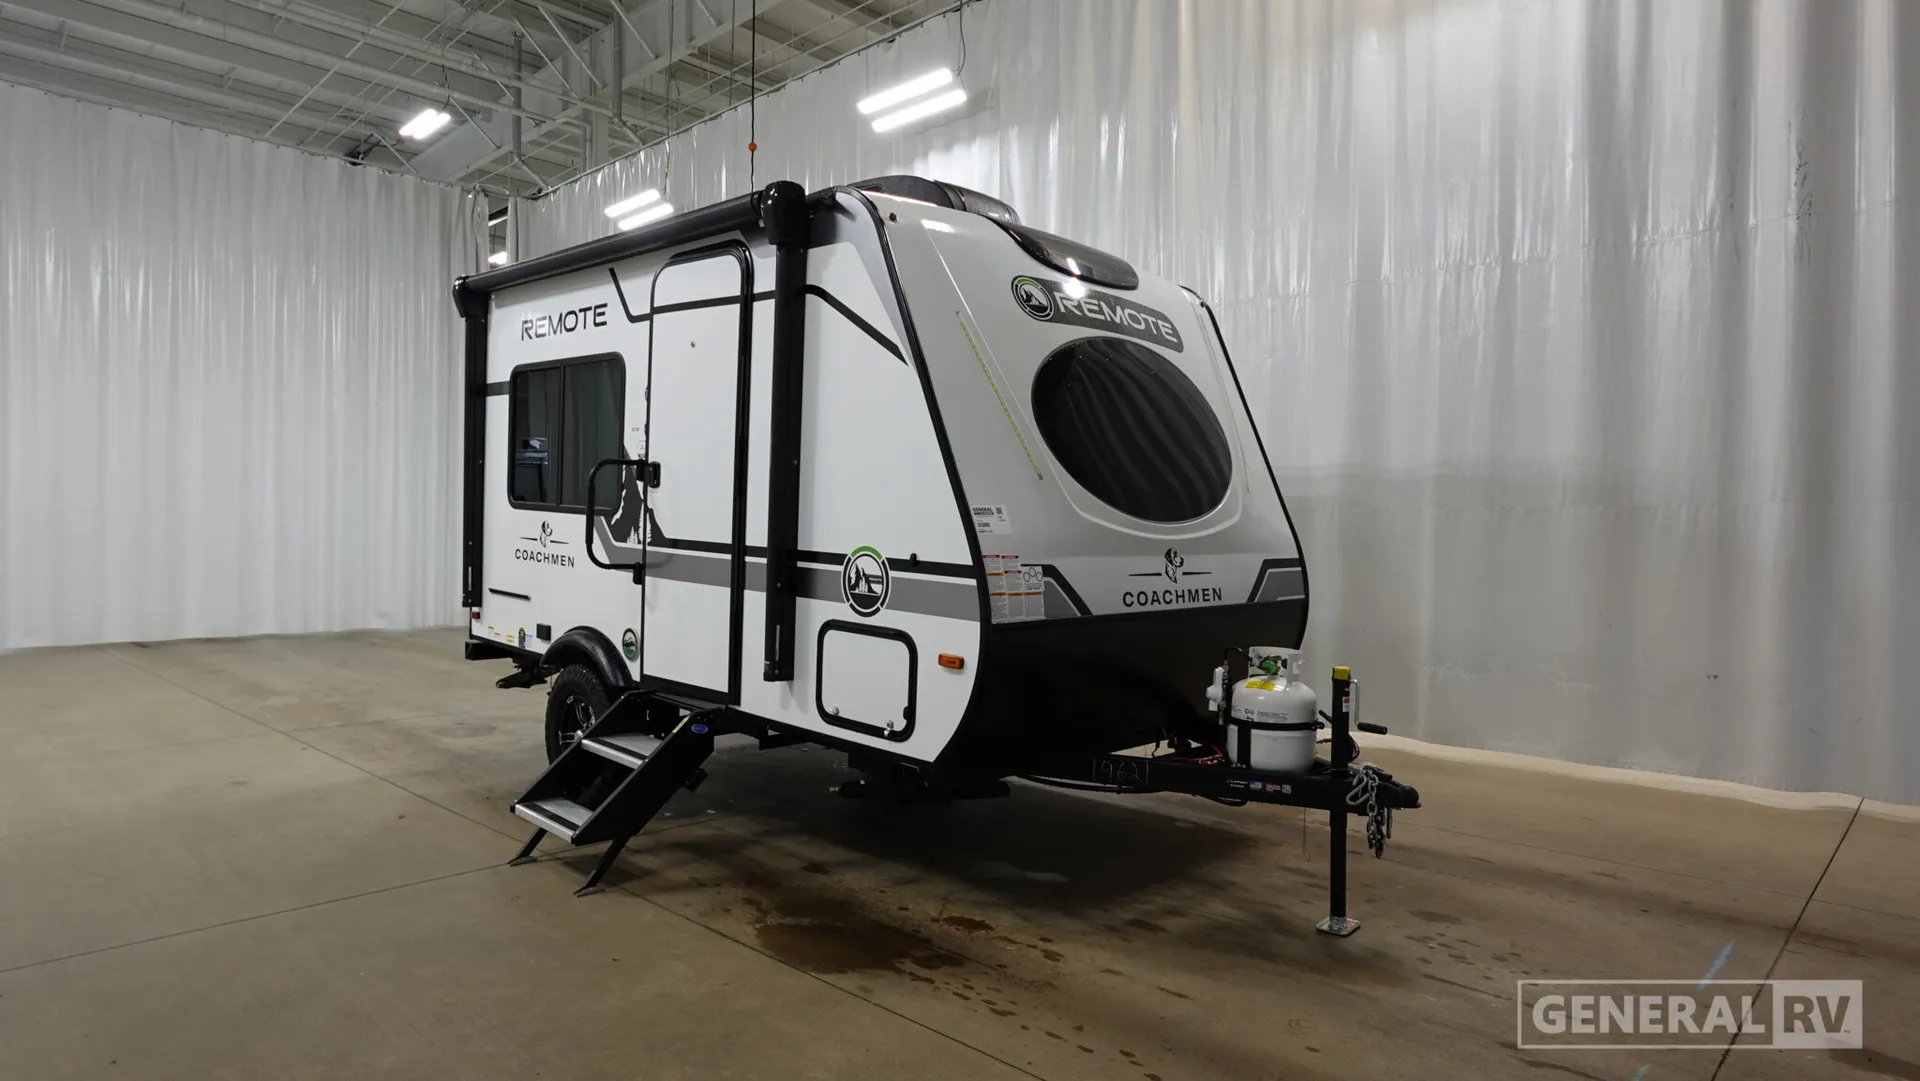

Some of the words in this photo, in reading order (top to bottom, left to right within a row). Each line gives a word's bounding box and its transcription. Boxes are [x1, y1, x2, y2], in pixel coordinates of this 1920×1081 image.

[521, 303, 608, 342] REMOTE
[1053, 292, 1178, 343] REMOTE
[515, 548, 575, 568] COACHMEN
[1122, 587, 1222, 608] COACHMEN
